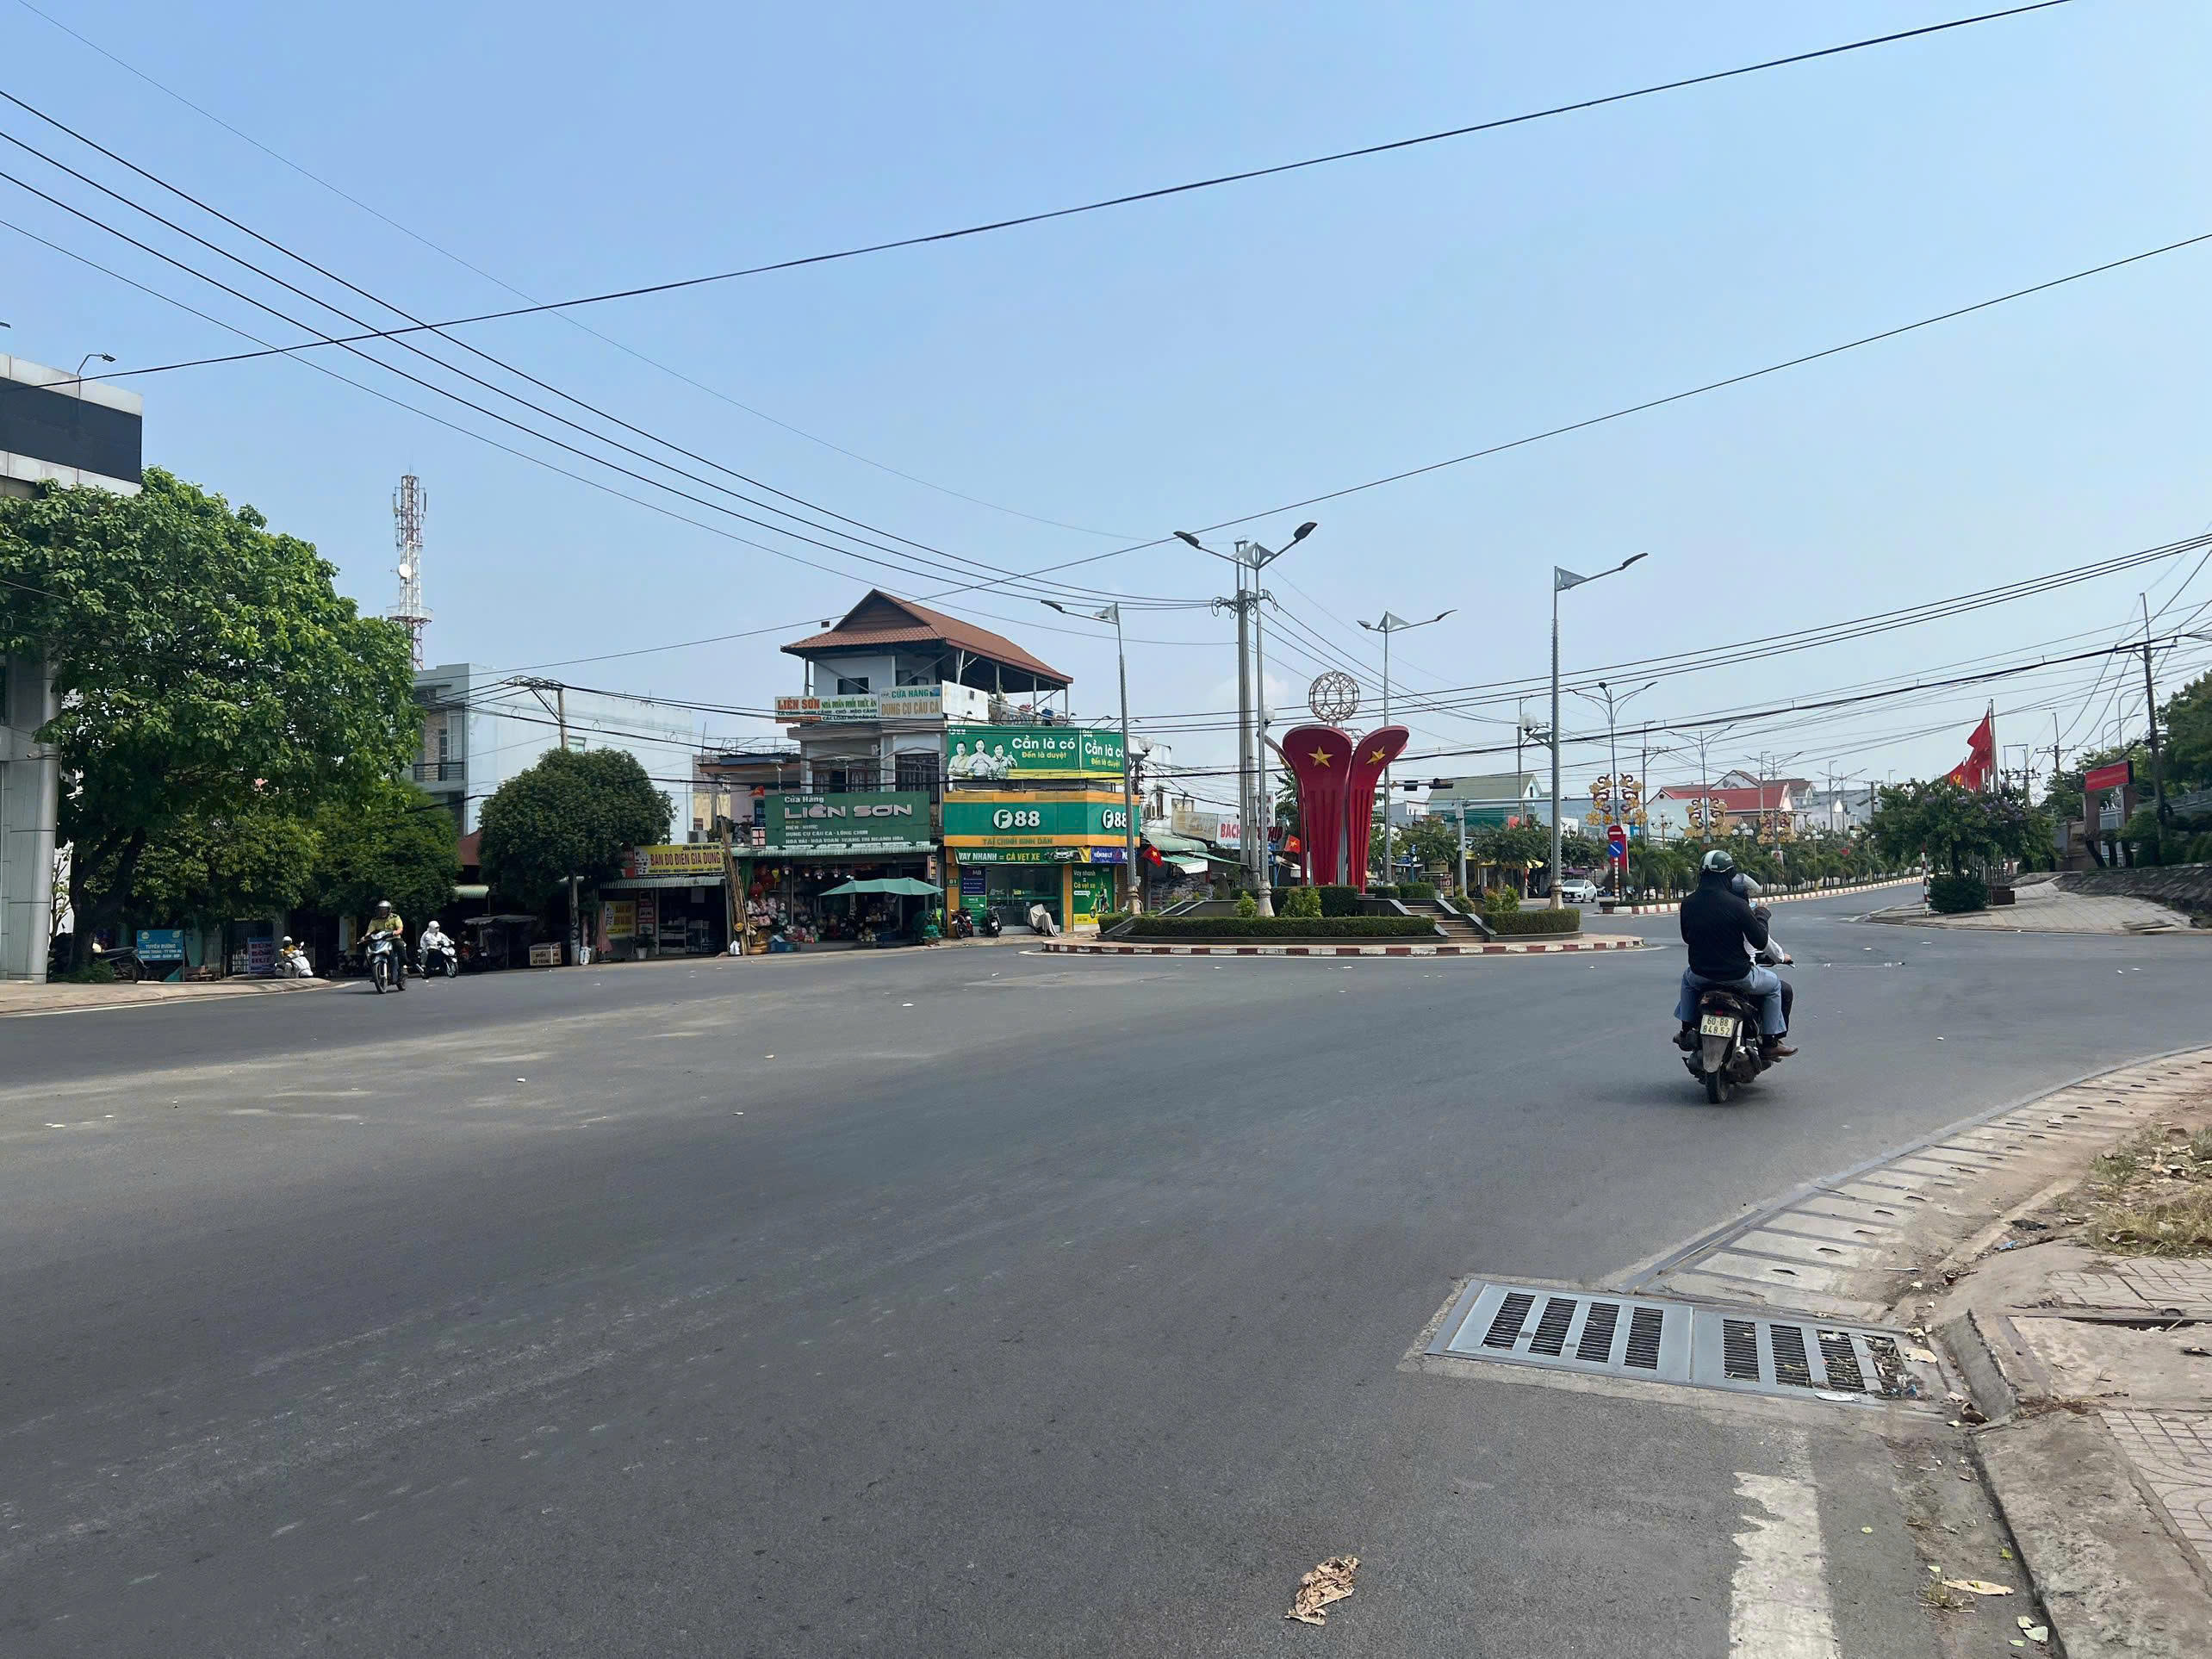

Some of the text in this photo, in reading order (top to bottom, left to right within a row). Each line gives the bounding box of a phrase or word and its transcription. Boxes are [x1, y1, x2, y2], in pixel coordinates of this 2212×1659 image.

[892, 688, 906, 698] CỬA
[909, 687, 929, 697] HÀNG
[778, 697, 799, 710] LIÊN
[1012, 734, 1076, 749] Cần là có
[1085, 739, 1103, 755] Cần
[1105, 743, 1113, 756] là
[1022, 750, 1066, 760] Đến là duyệt
[784, 794, 824, 804] Cửa Hàng
[784, 804, 912, 819] LIÊN SƠN
[993, 809, 1041, 829] F88
[958, 852, 972, 861] VAY
[972, 852, 997, 861] NHANH
[1006, 851, 1016, 861] CÀ
[1030, 852, 1041, 861] XE
